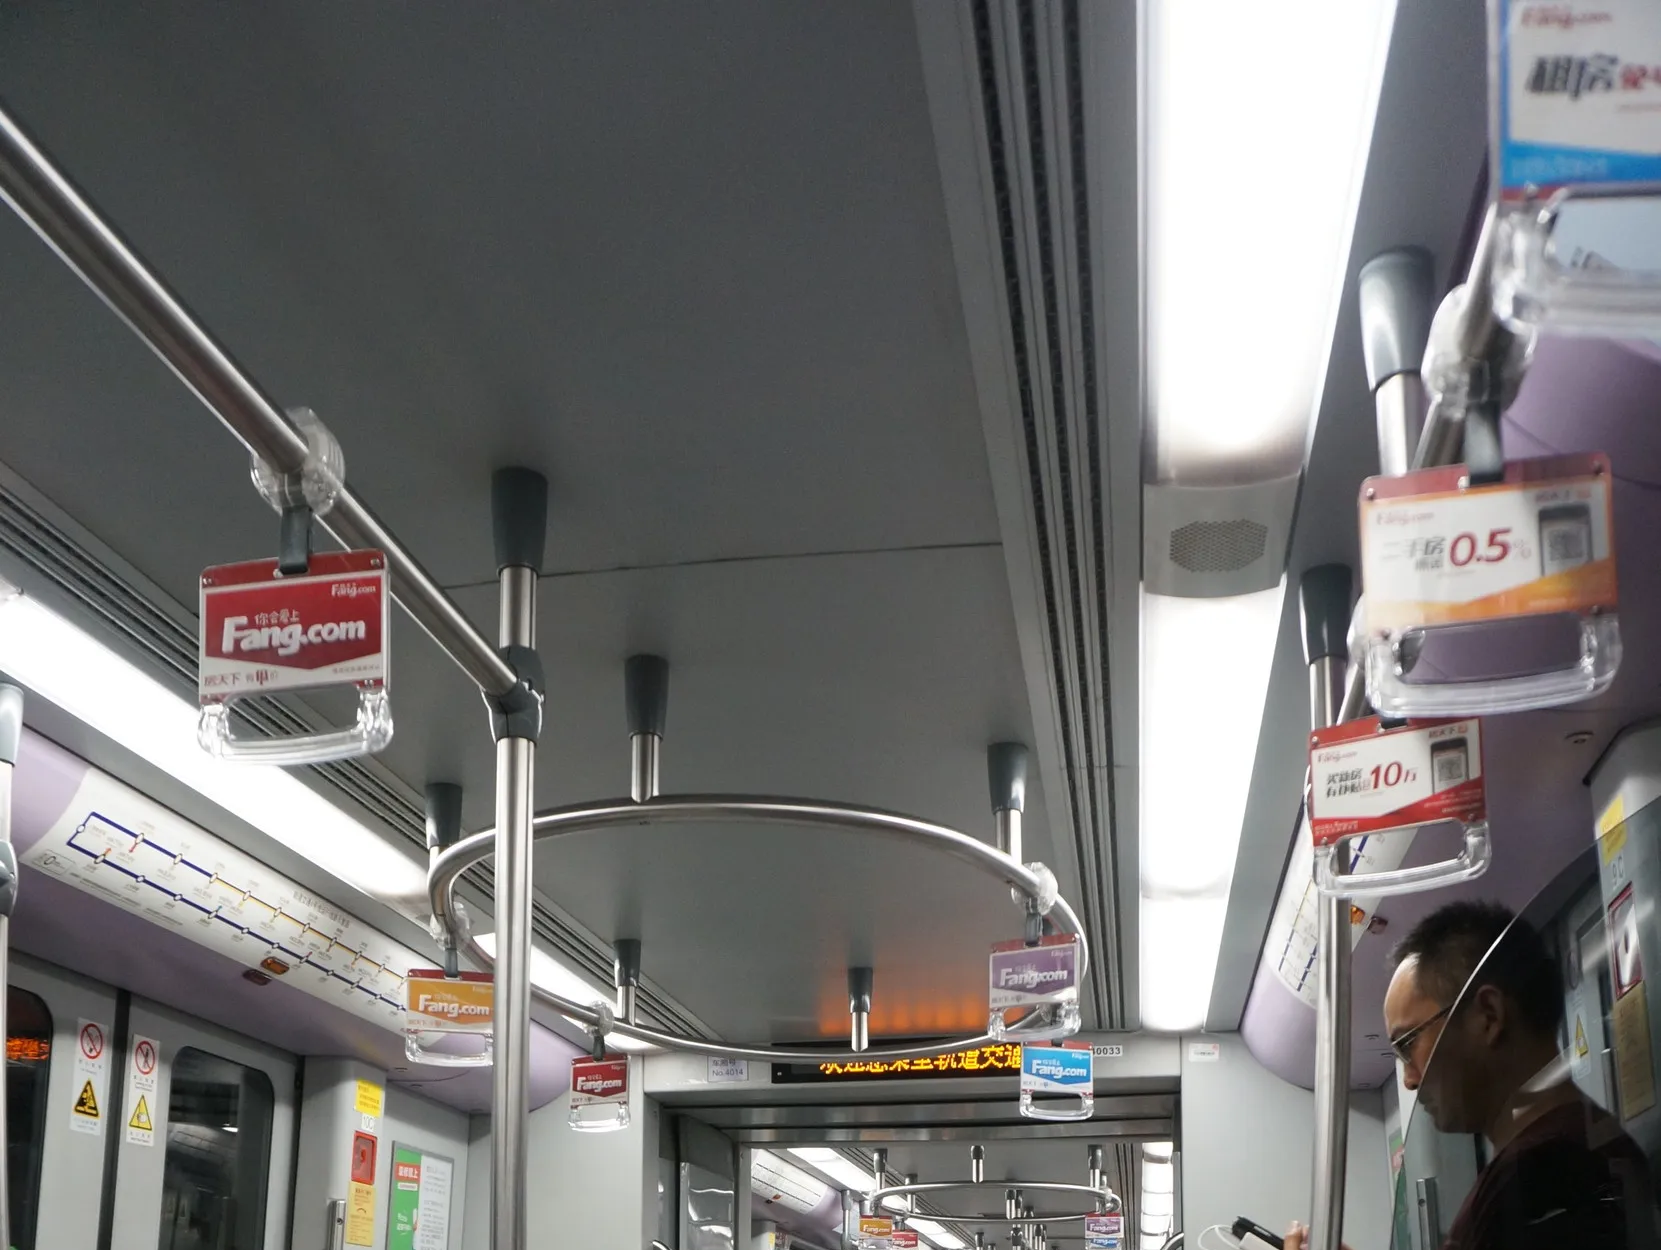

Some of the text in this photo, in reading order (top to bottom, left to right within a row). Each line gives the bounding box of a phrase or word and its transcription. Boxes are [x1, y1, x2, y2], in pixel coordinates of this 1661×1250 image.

[331, 583, 377, 598] Fang.com
[254, 608, 300, 626] 你会爱上
[222, 615, 366, 657] Fang.com
[1000, 967, 1068, 989] Fang.com
[418, 994, 490, 1018] Fang.com
[1031, 1059, 1087, 1079] Fang.com
[577, 1076, 622, 1093] Fang.com
